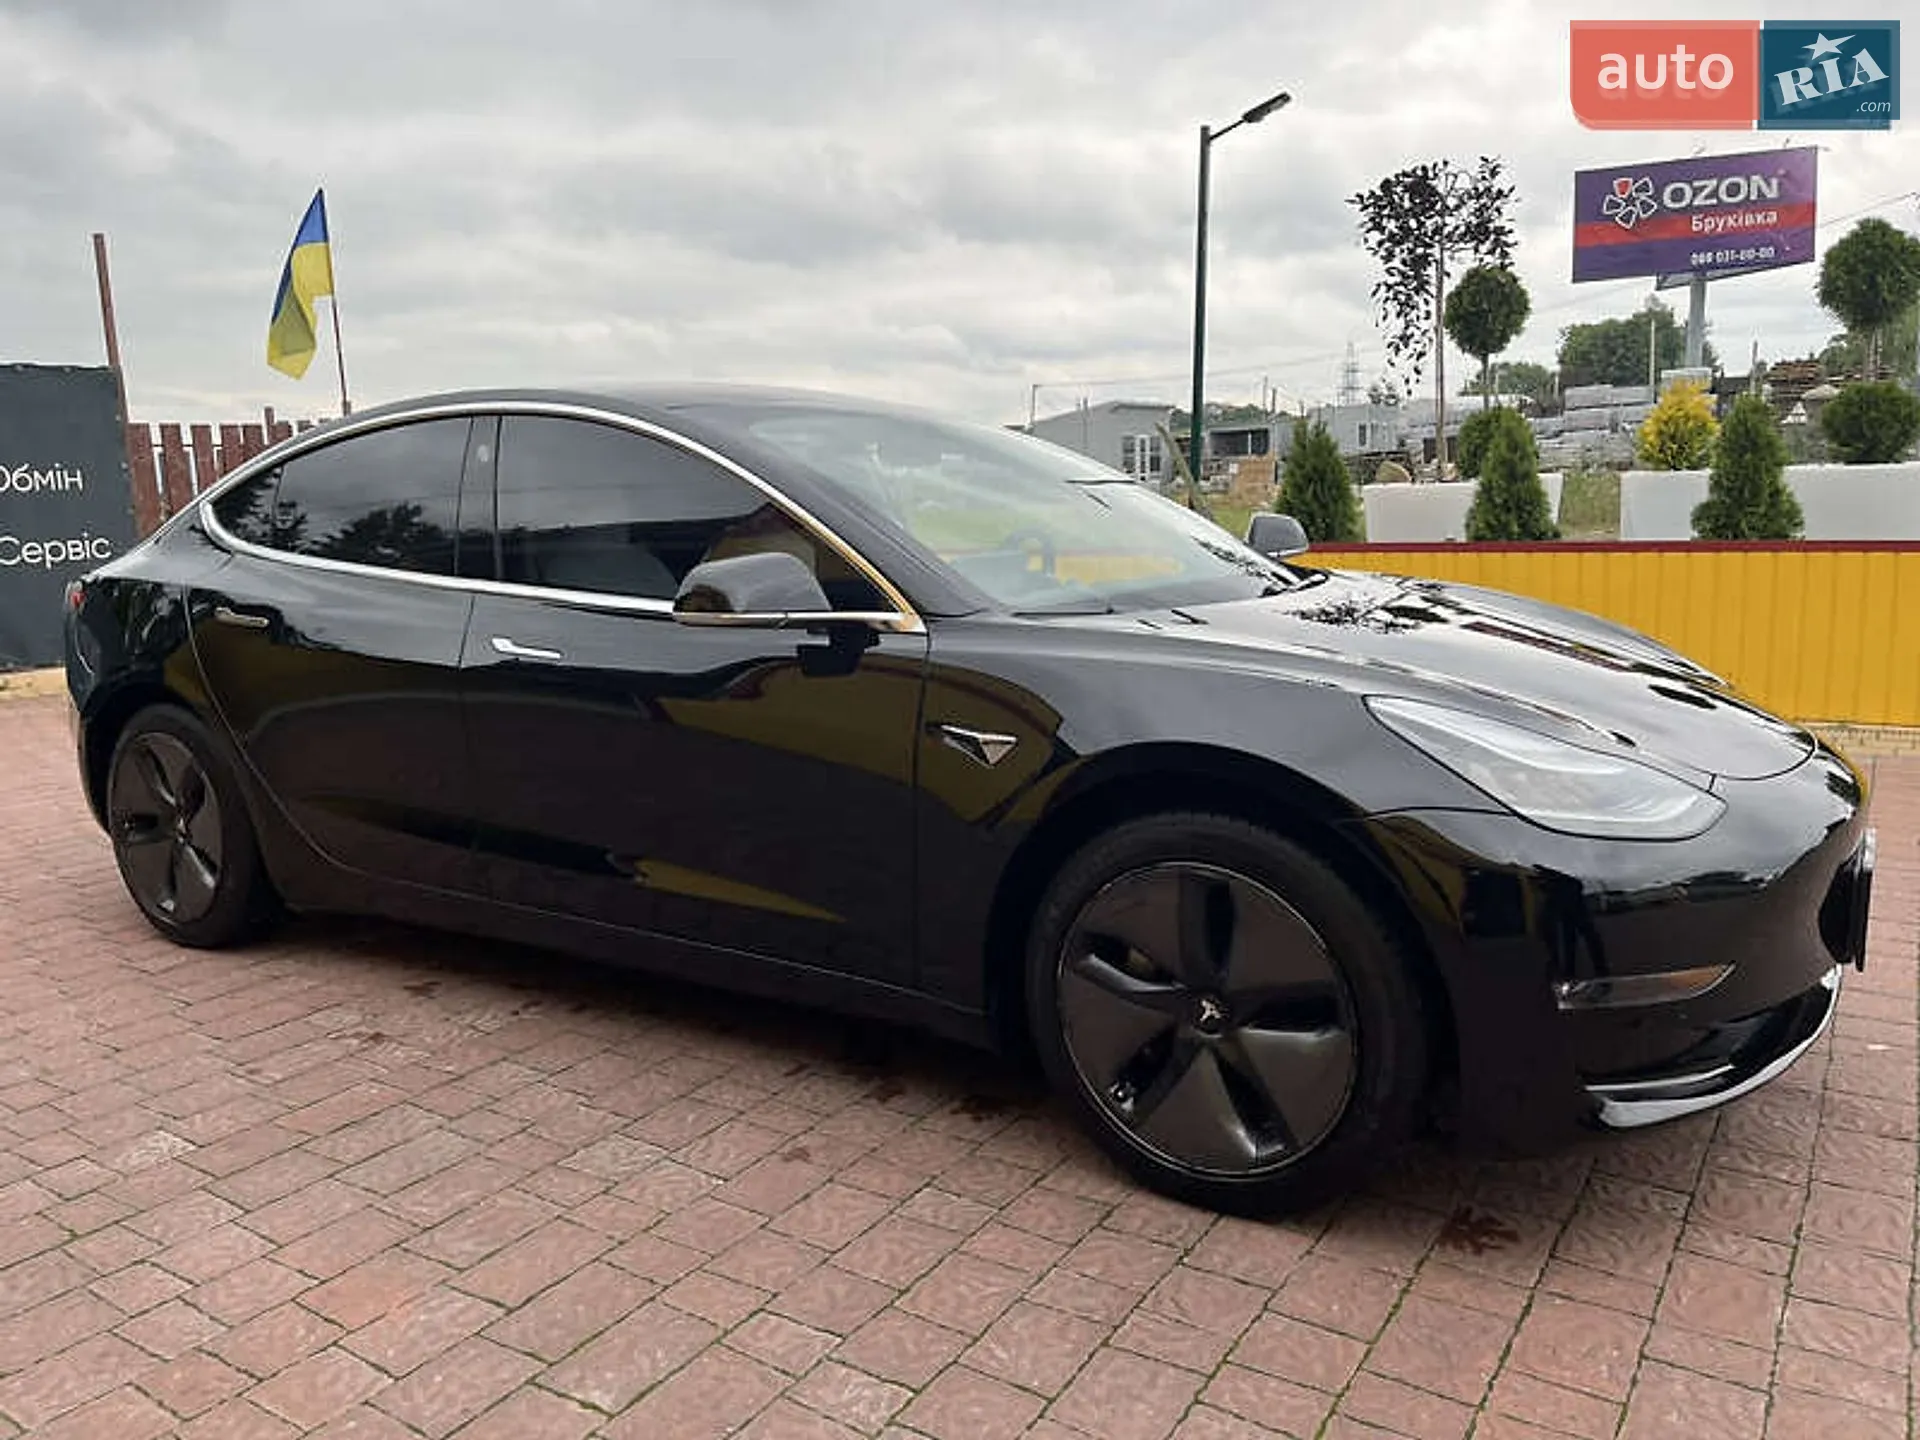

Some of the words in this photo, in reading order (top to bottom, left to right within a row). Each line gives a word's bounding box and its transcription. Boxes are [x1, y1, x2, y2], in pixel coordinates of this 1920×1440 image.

[1662, 175, 1779, 209] OZON
[1691, 209, 1778, 234] Бруківка
[0, 531, 112, 568] Сервіс
